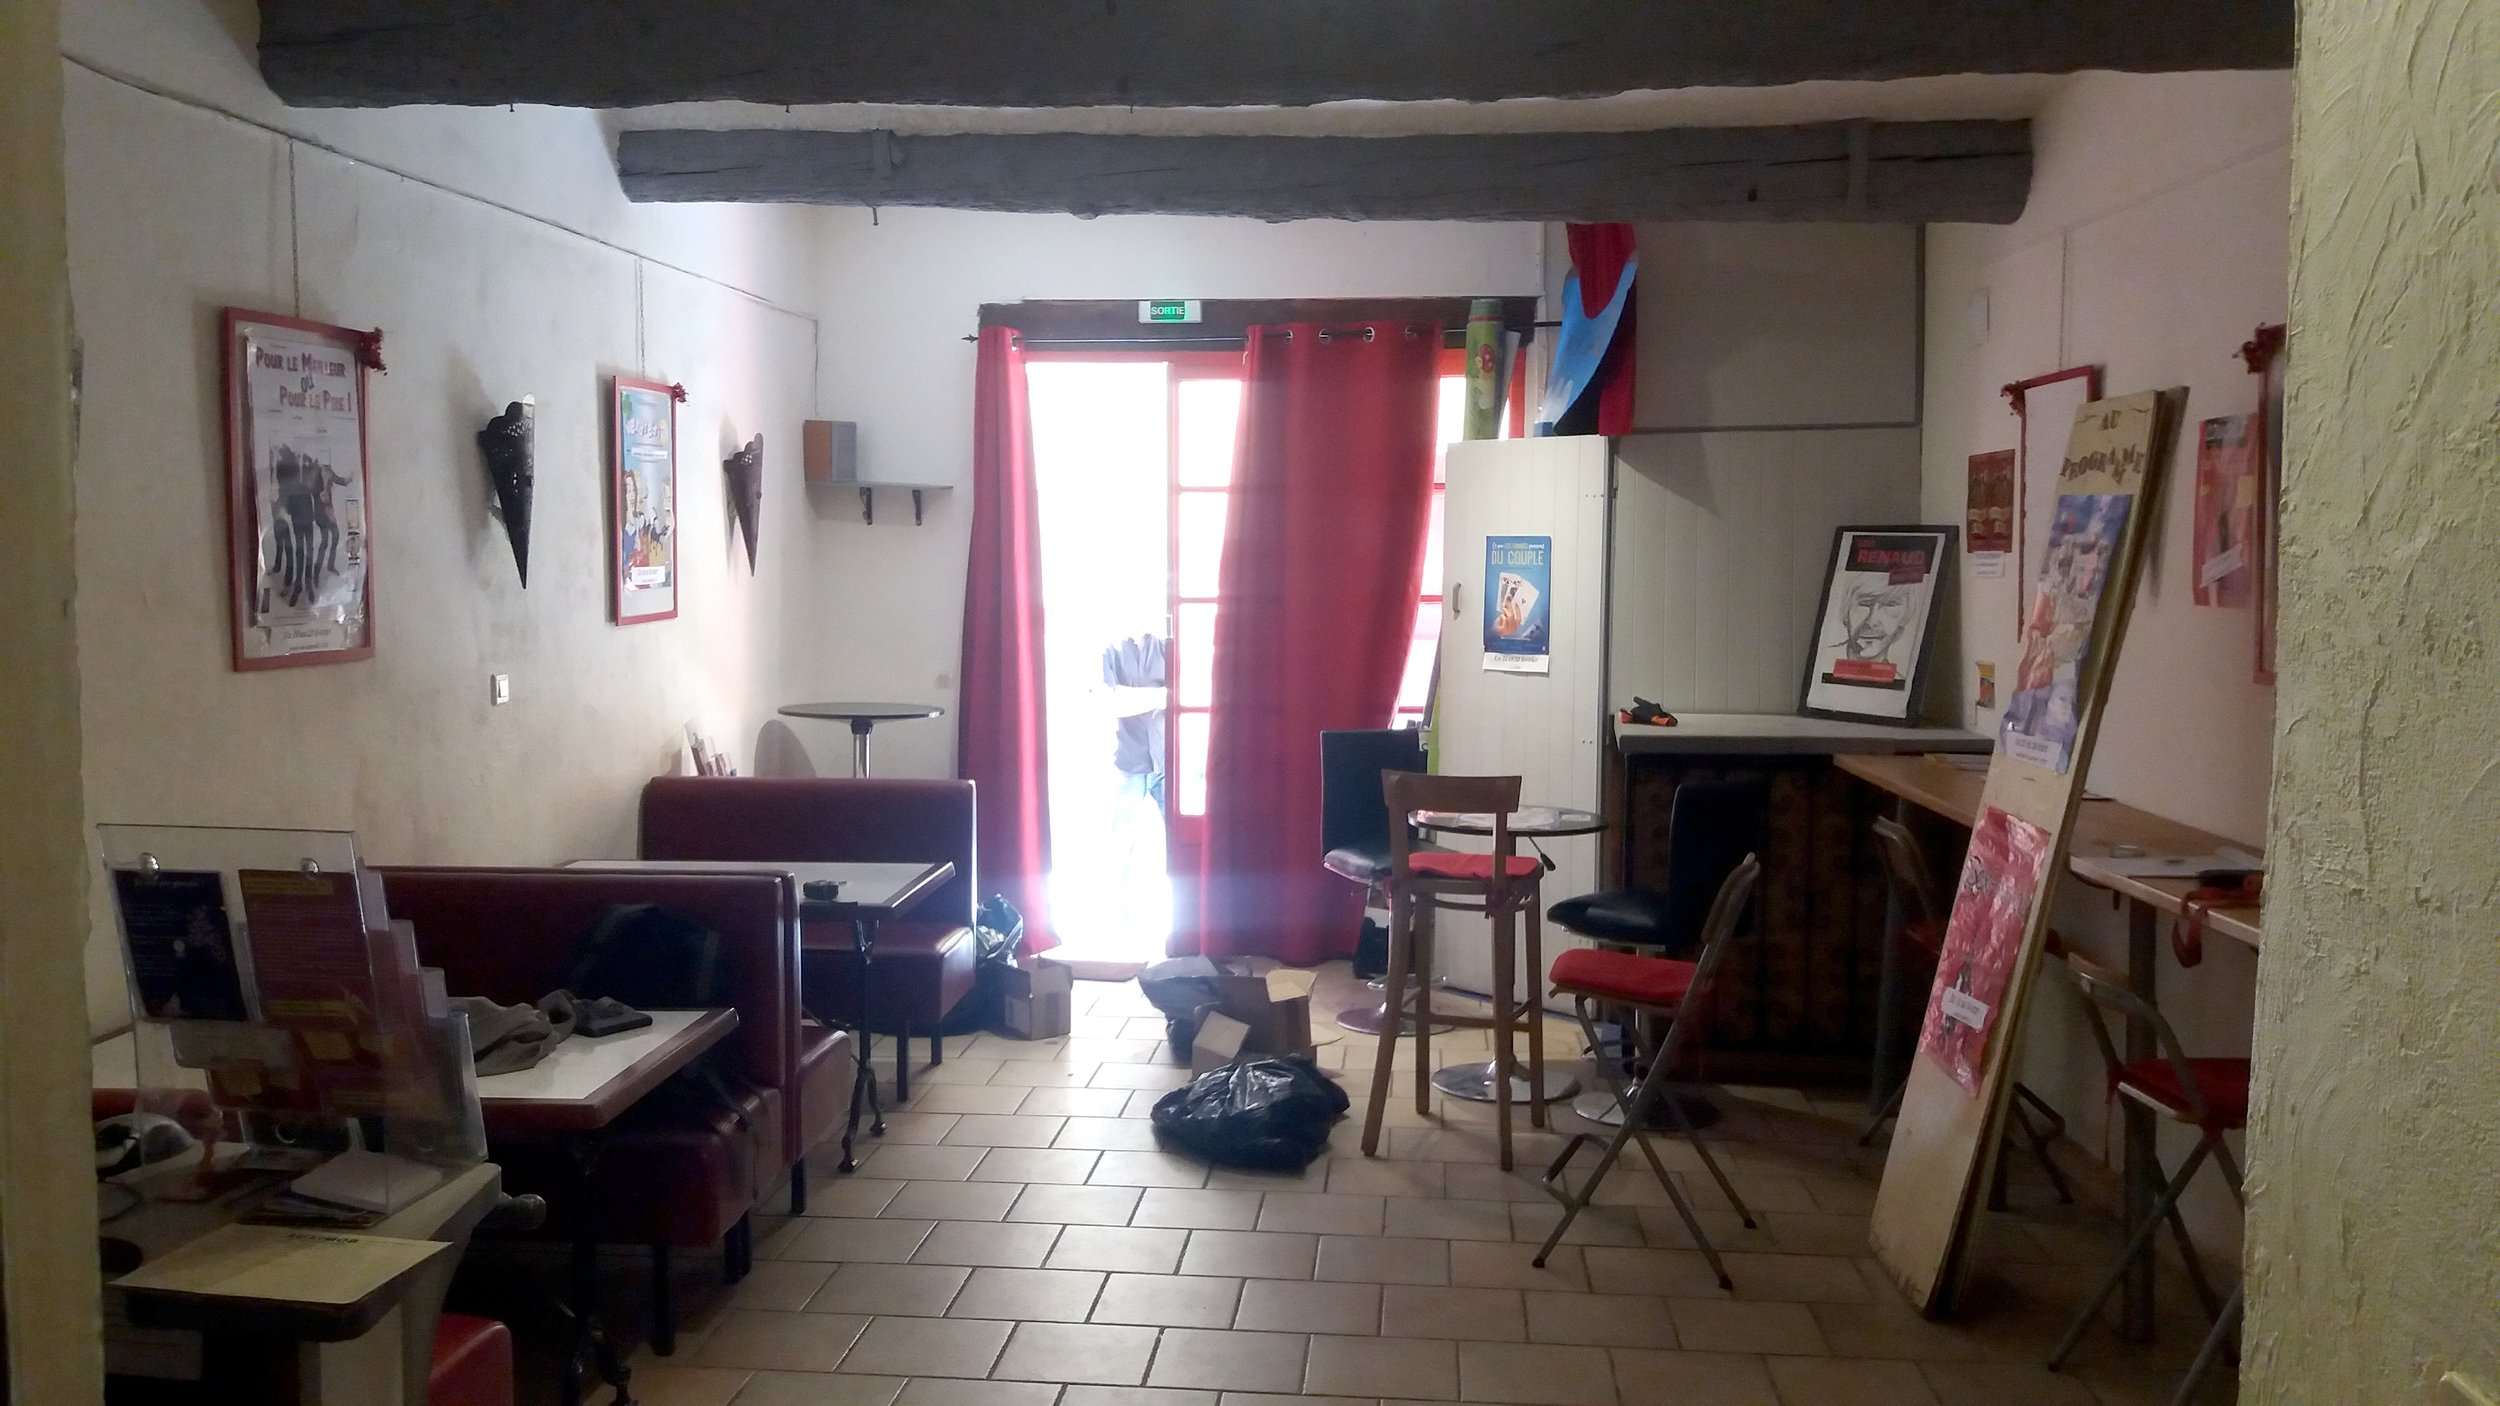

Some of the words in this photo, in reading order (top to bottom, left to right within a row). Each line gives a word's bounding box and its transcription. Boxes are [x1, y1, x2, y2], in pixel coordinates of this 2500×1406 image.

[1151, 306, 1185, 315] SORTIE
[255, 346, 283, 371] POUR
[287, 356, 299, 372] LE
[302, 352, 346, 378] MEILLEUR
[279, 385, 308, 409] POUR
[2099, 410, 2122, 431] AU
[1491, 550, 1504, 565] DU
[1508, 550, 1544, 566] COUPLE
[1856, 549, 1926, 565] RENAUD
